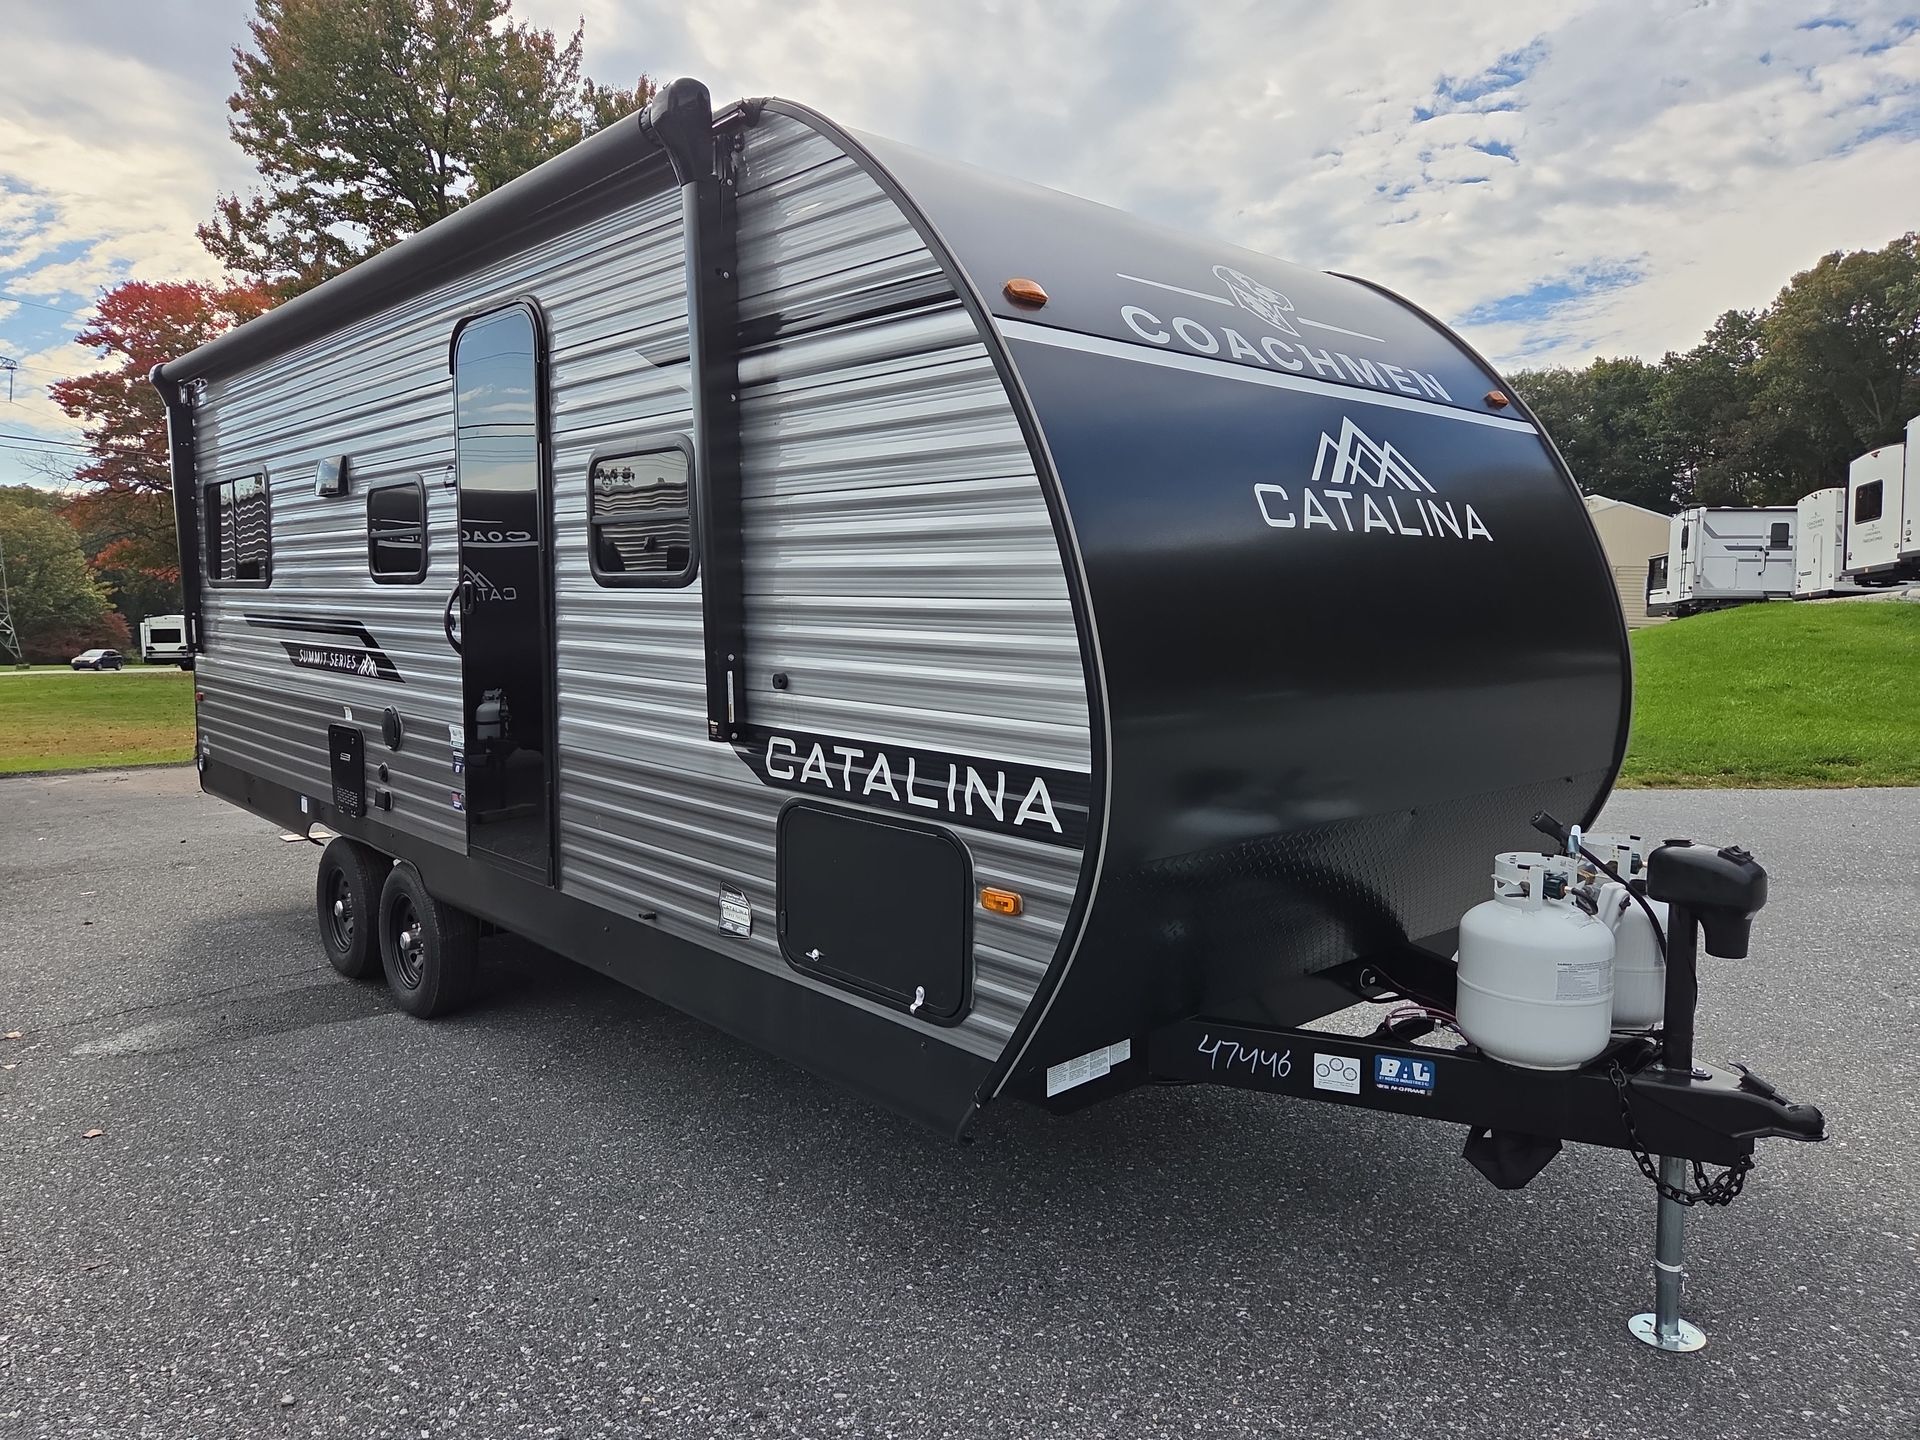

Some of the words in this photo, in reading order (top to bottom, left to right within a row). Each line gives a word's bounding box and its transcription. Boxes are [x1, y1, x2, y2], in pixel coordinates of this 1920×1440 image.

[1121, 304, 1453, 402] COACHMEN
[1253, 482, 1494, 542] CATALINA
[298, 649, 328, 666] SUMMIT
[329, 652, 357, 670] SERIES
[765, 735, 1063, 834] CATALINA
[1197, 1033, 1292, 1078] 47446
[1379, 1057, 1430, 1082] BAL
